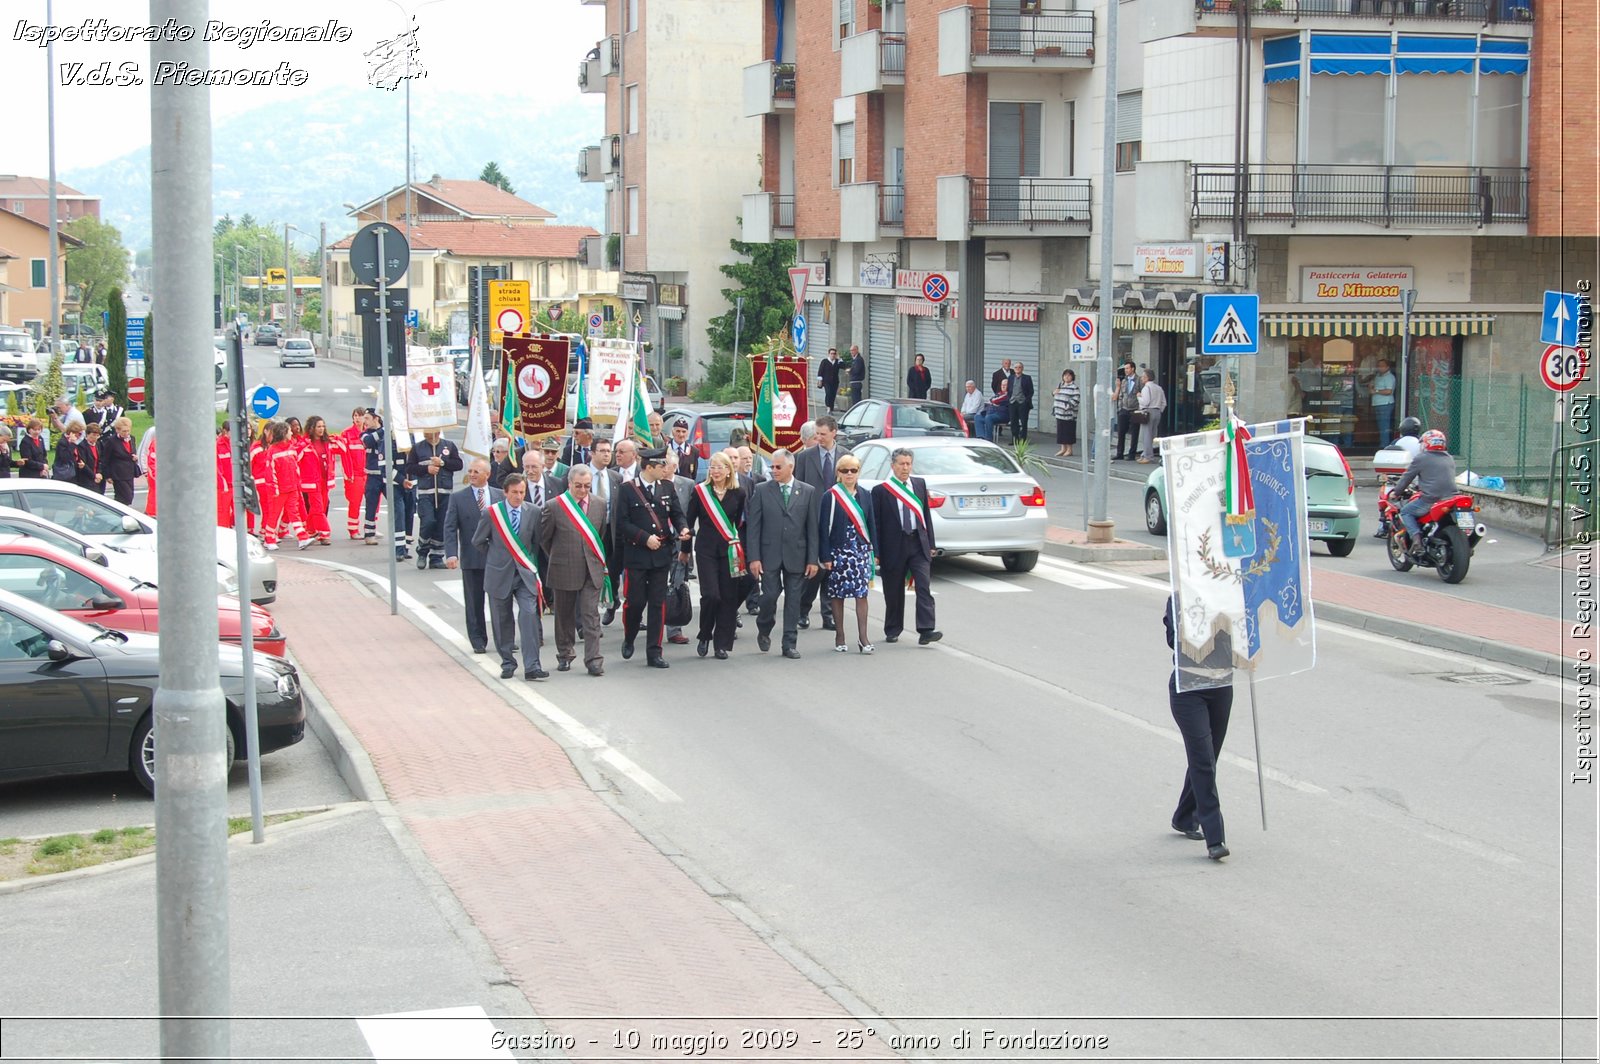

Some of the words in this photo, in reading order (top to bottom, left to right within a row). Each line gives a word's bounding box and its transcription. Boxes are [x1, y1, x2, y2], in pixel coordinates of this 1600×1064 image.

[1136, 246, 1165, 255] Pasticceria
[1168, 246, 1193, 255] Gelateria
[1144, 257, 1154, 272] La
[1156, 257, 1184, 272] Mimosa
[1310, 272, 1360, 280] Pasticceria
[1366, 272, 1407, 280] Gelateria
[1317, 283, 1338, 298] La
[1342, 283, 1400, 298] Mimosa
[1552, 354, 1578, 378] 30
[528, 408, 554, 419] GASSINO
[1255, 471, 1290, 500] TORINESE
[1180, 482, 1207, 513] COMUNE
[1208, 475, 1217, 488] DI
